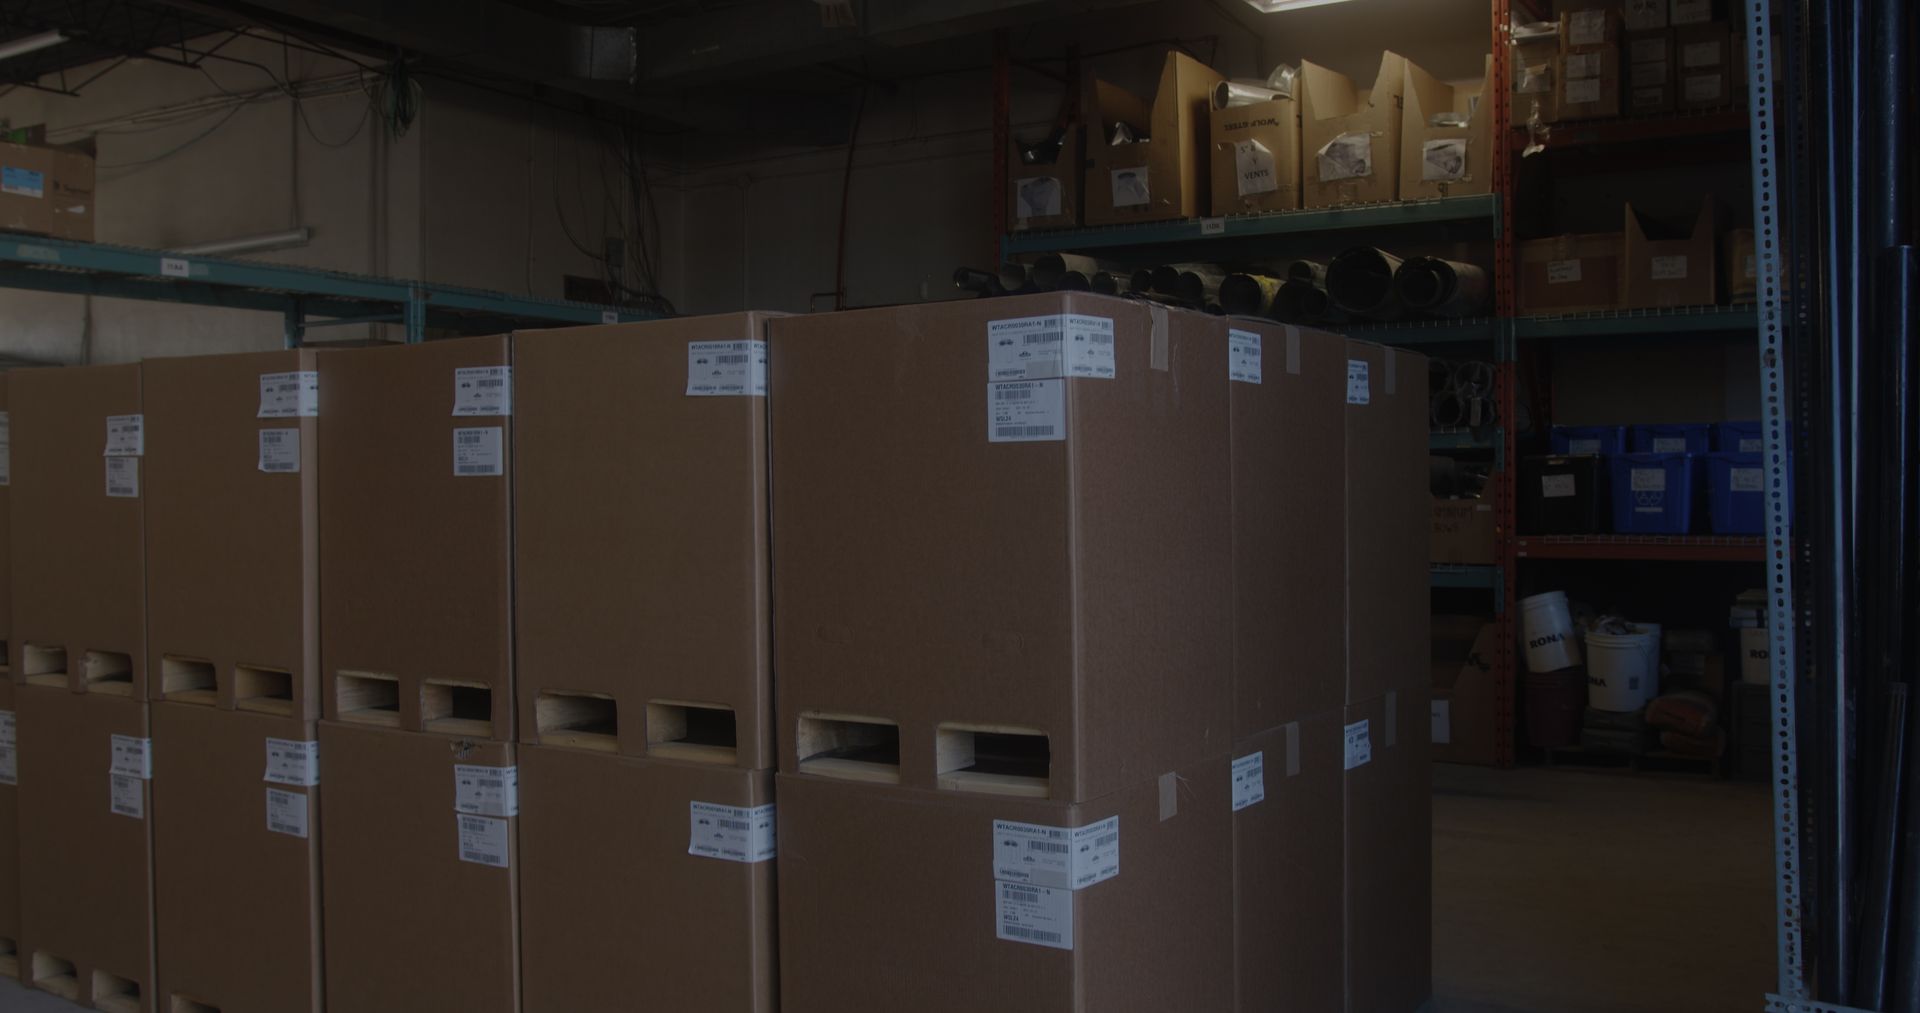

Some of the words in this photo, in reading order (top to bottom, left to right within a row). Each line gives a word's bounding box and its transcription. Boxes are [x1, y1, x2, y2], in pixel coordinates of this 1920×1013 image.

[1245, 169, 1270, 180] VENTS
[1529, 633, 1565, 649] RONA
[1750, 649, 1769, 659] RO
